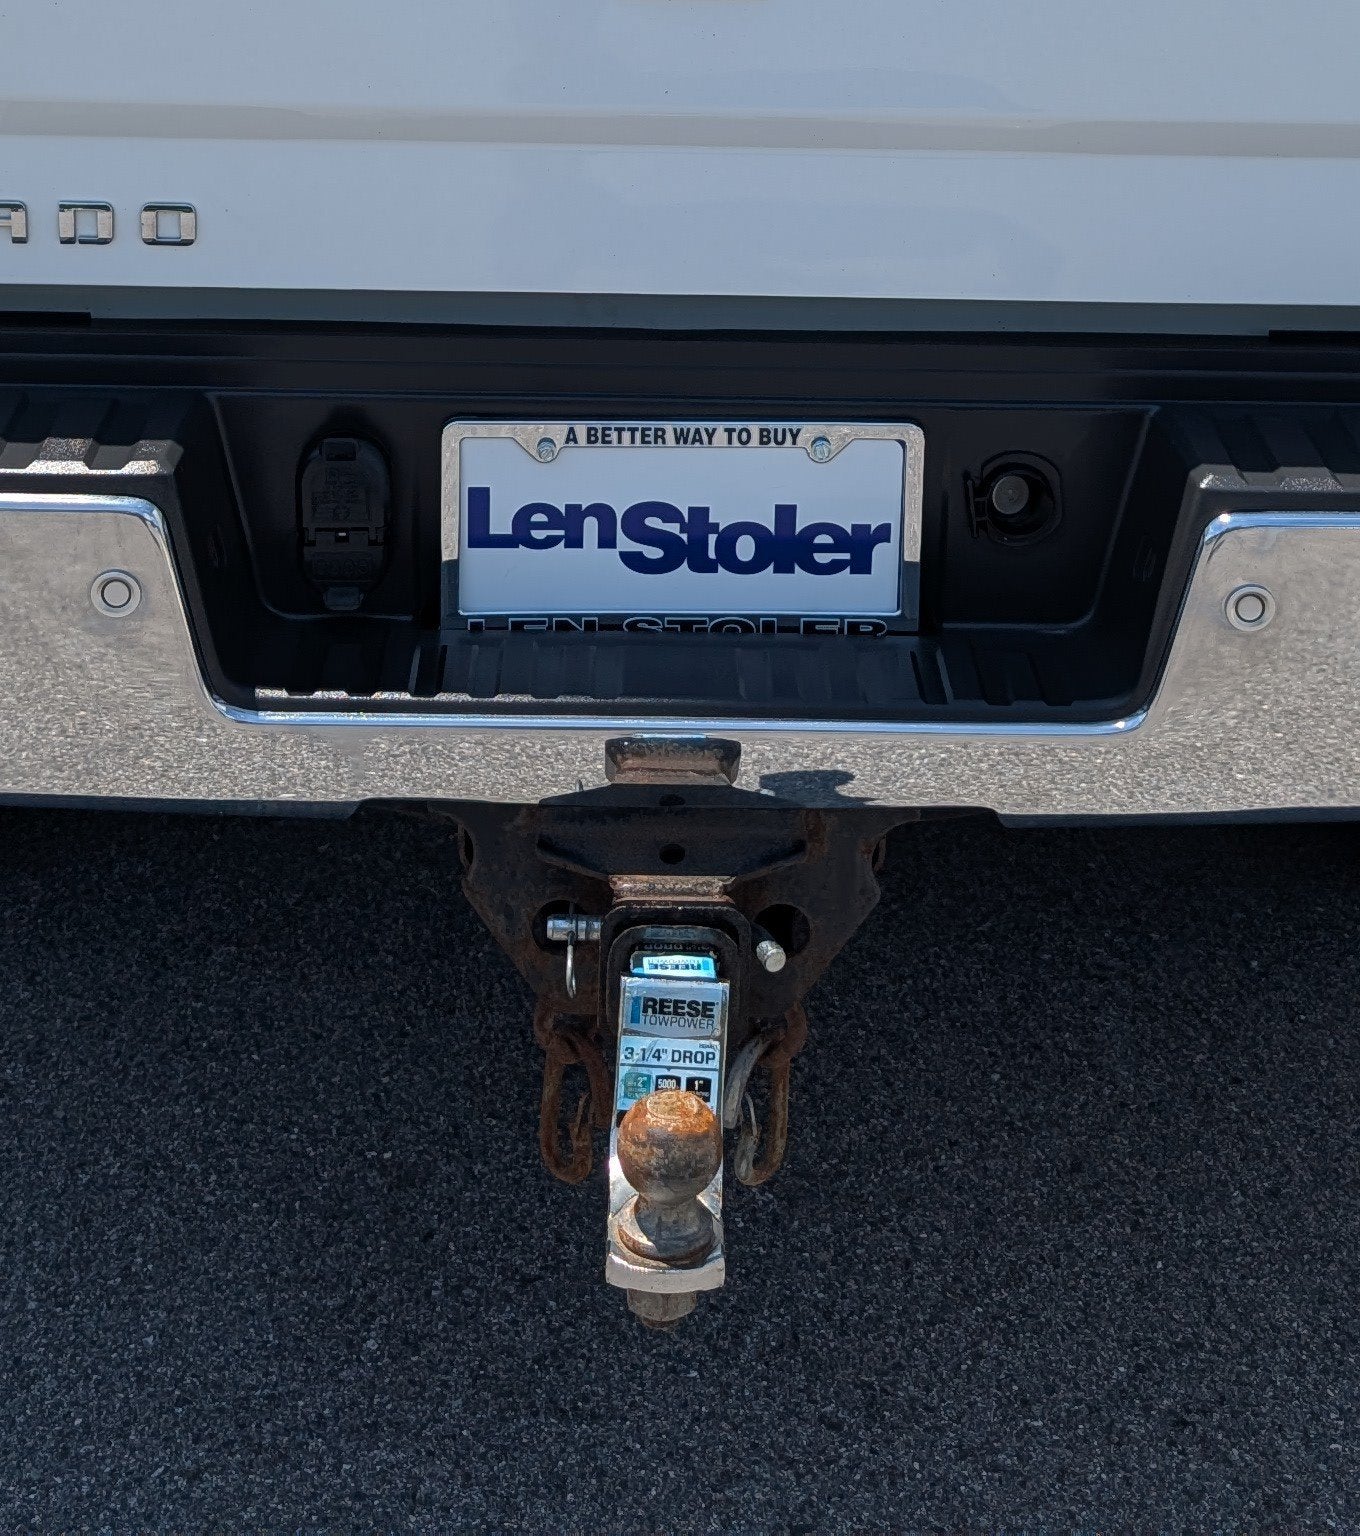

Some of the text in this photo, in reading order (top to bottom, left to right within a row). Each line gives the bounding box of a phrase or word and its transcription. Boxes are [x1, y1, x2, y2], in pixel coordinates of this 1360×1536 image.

[564, 426, 802, 445] A BETTER WAY TO BUY
[642, 996, 715, 1018] REESE
[642, 1014, 715, 1030] TOWPOWER
[671, 1049, 716, 1064] DROP
[658, 1078, 677, 1089] 5000
